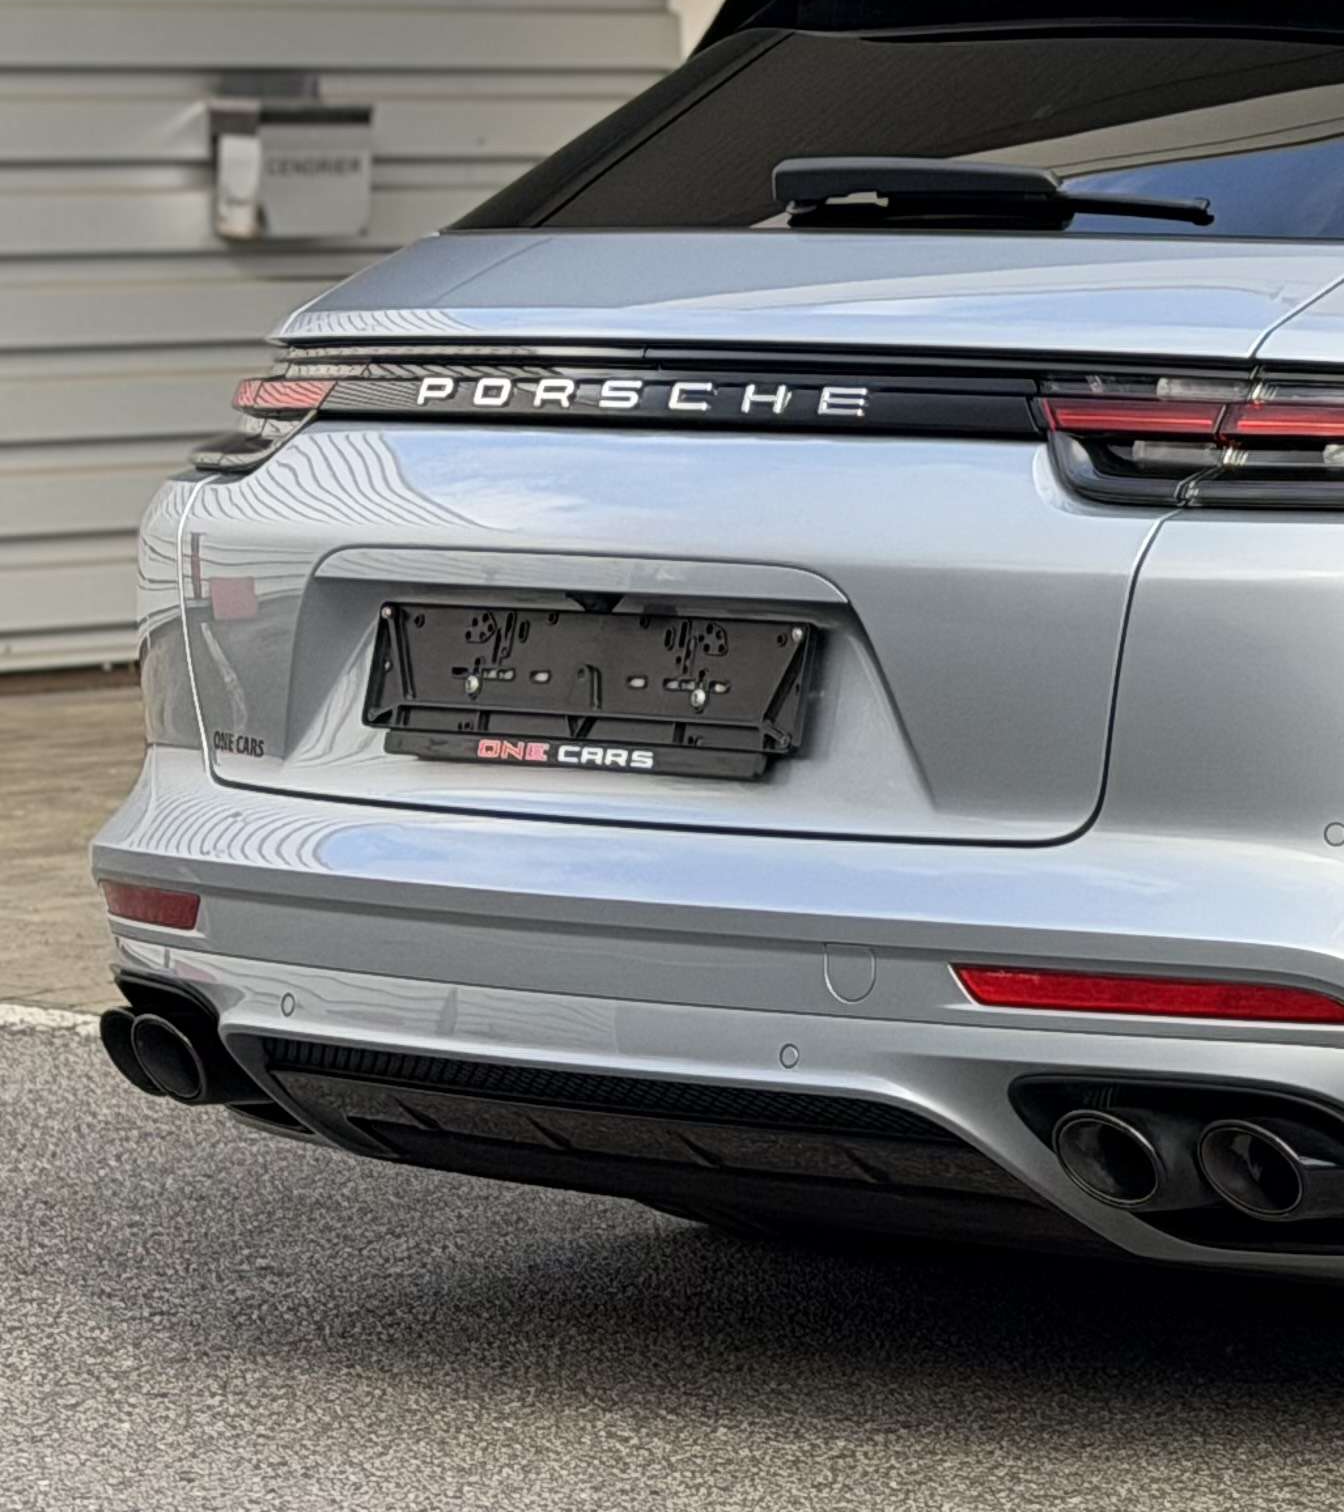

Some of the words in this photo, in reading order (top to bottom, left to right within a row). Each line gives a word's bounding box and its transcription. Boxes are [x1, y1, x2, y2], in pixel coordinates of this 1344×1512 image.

[416, 376, 869, 417] PORSCHE
[213, 730, 234, 753] ONE
[236, 735, 265, 758] CARS
[477, 739, 550, 762] ONE
[557, 745, 654, 769] CARS
